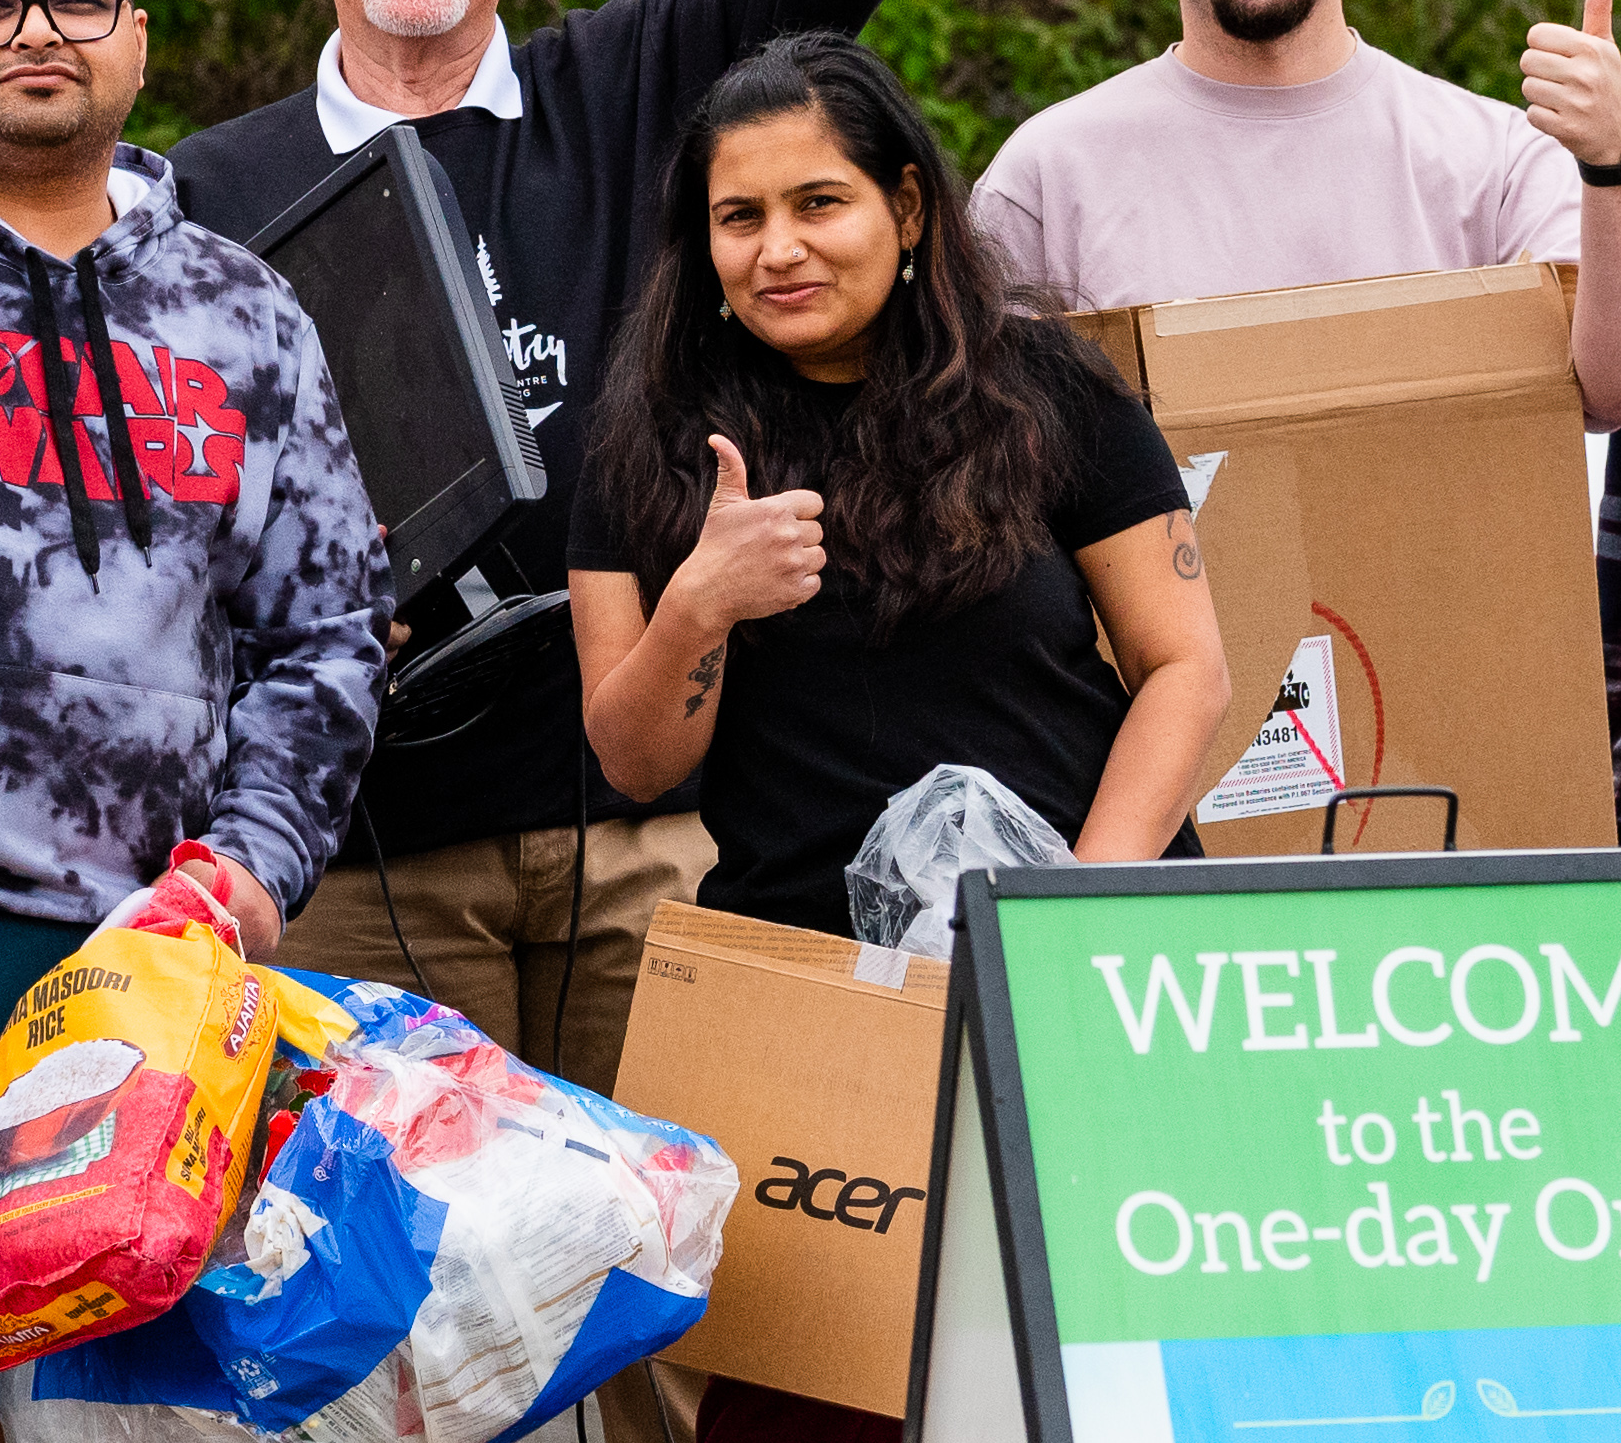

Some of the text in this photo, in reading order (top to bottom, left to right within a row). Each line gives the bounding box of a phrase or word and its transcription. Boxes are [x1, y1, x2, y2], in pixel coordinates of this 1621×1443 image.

[1252, 726, 1298, 747] N3481
[32, 967, 132, 1013] MASOORI
[229, 981, 259, 1052] AJANTA
[26, 1006, 66, 1050] RICE
[1317, 1089, 1543, 1167] to the
[755, 1156, 926, 1235] acer
[1115, 1182, 1511, 1284] One-day
